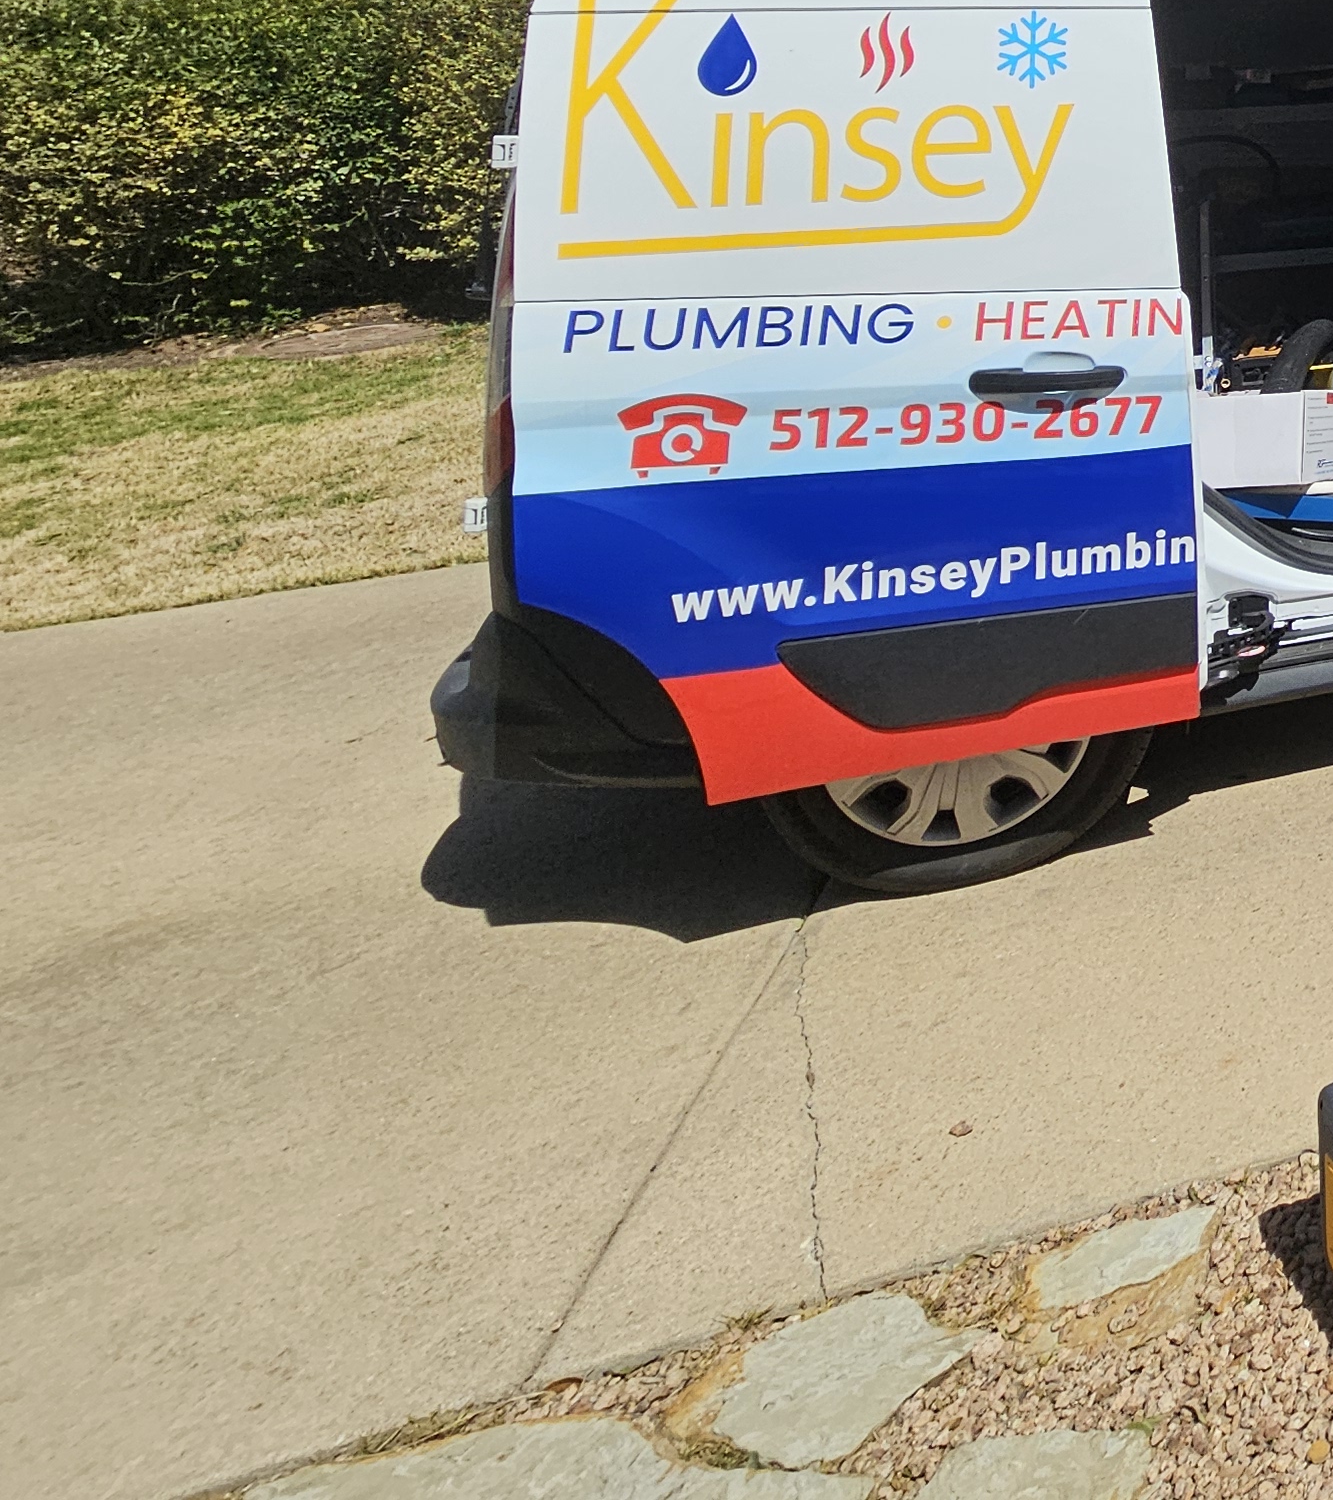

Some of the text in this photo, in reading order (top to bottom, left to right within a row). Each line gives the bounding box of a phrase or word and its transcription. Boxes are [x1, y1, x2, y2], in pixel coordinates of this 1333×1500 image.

[563, 298, 1183, 354] PLUMBING HEATIN
[769, 396, 1163, 451] 512-930-2677
[671, 529, 1197, 624] www.KinseyPlumbin
